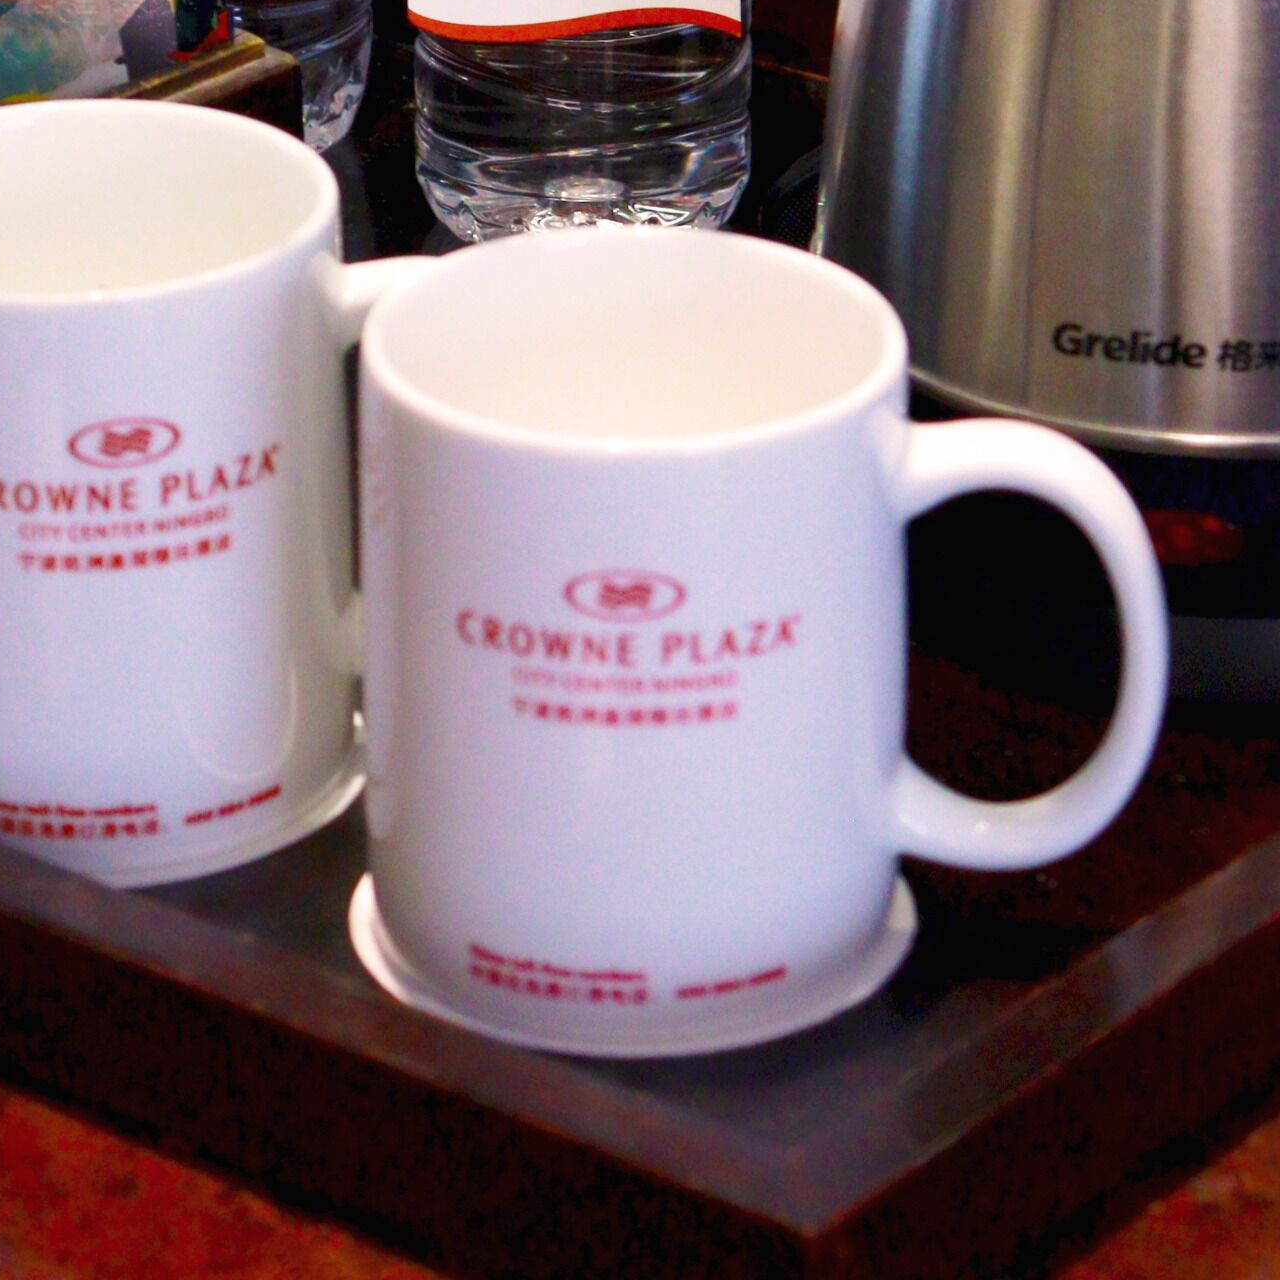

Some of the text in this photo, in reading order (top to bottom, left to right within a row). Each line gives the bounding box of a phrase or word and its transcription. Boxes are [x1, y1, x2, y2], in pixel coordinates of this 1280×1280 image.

[1052, 323, 1208, 369] Grelide
[158, 445, 278, 506] PLAZA
[456, 609, 798, 667] CROWNE PLAZA
